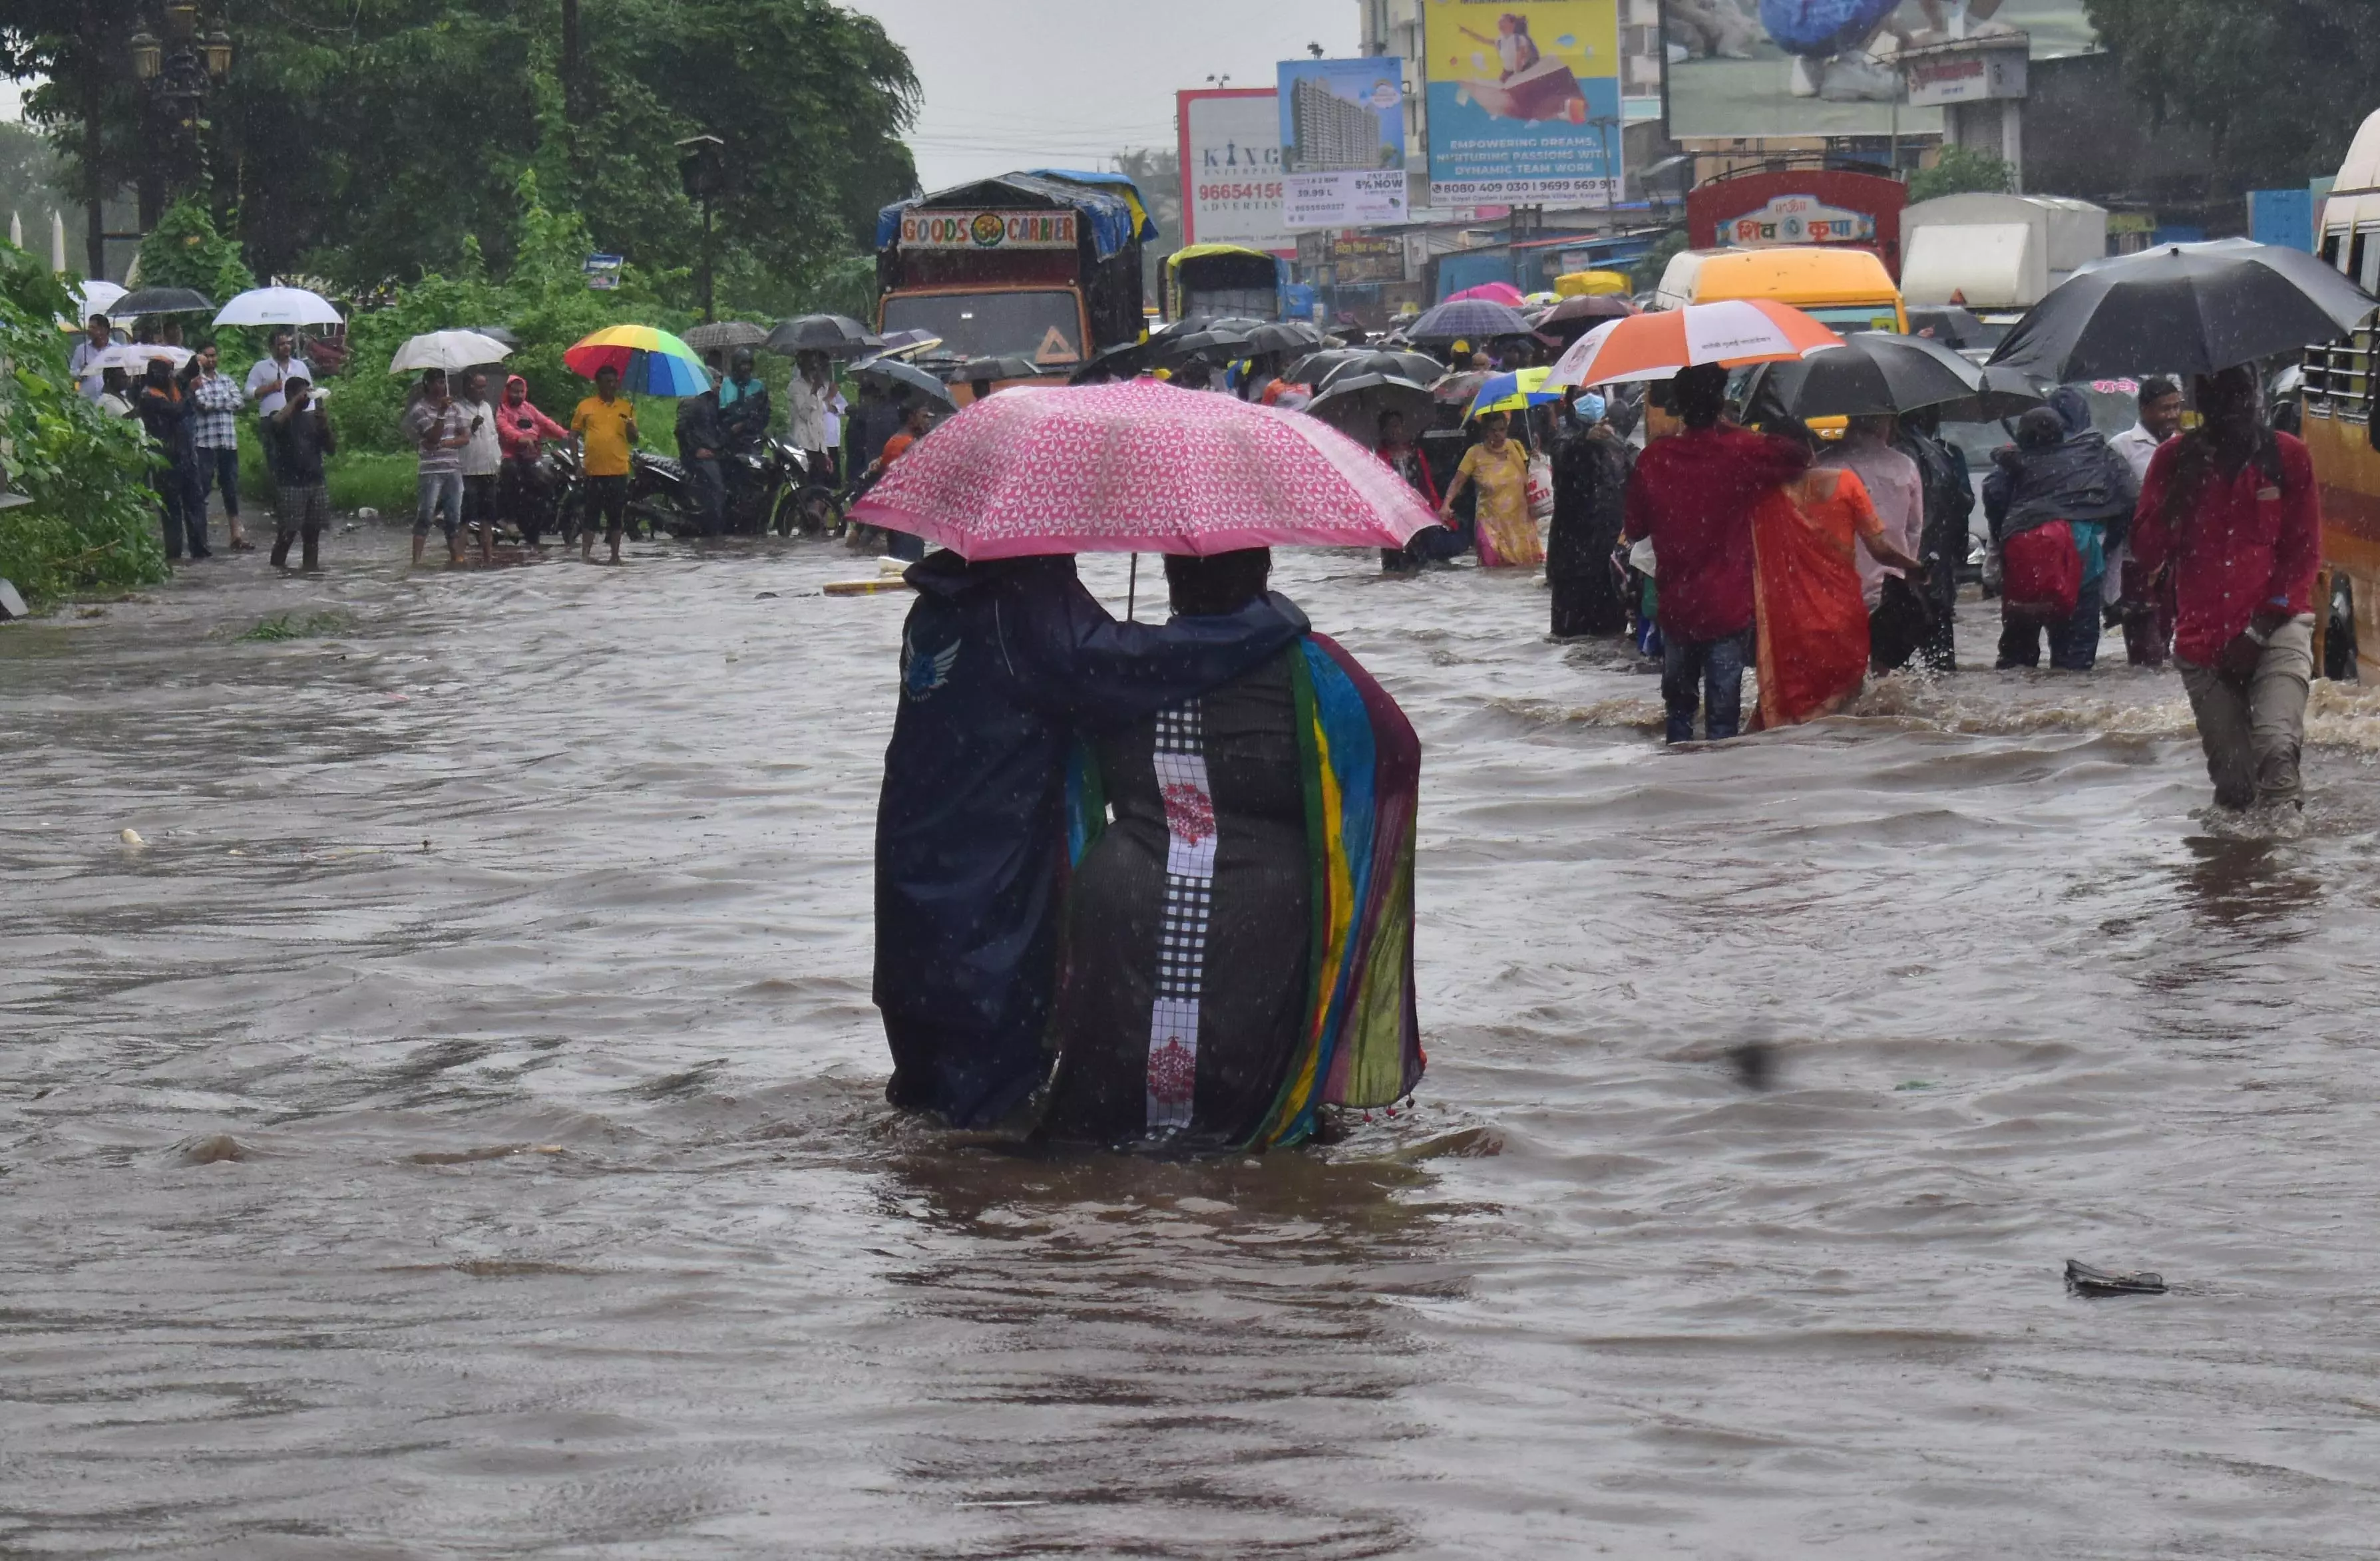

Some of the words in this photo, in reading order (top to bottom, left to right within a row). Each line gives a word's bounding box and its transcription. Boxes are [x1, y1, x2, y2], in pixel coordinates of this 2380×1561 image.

[1450, 138, 1537, 149] EMPOWERING
[1541, 137, 1596, 146] DREAMS,
[1436, 152, 1508, 162] NURTURING
[1513, 150, 1573, 160] PASSIONS
[1455, 165, 1512, 175] DYNAMIC
[1516, 164, 1549, 174] TEAM
[1555, 162, 1593, 172] WORK
[1355, 180, 1373, 190] 5%
[1374, 179, 1403, 189] NOW
[1444, 184, 1475, 193] 8080
[1479, 183, 1502, 192] 409
[1506, 182, 1529, 192] 030
[1539, 181, 1570, 191] 9699
[1573, 180, 1596, 190] 669
[902, 218, 968, 244] GOODS
[1007, 218, 1076, 241] CARRIER
